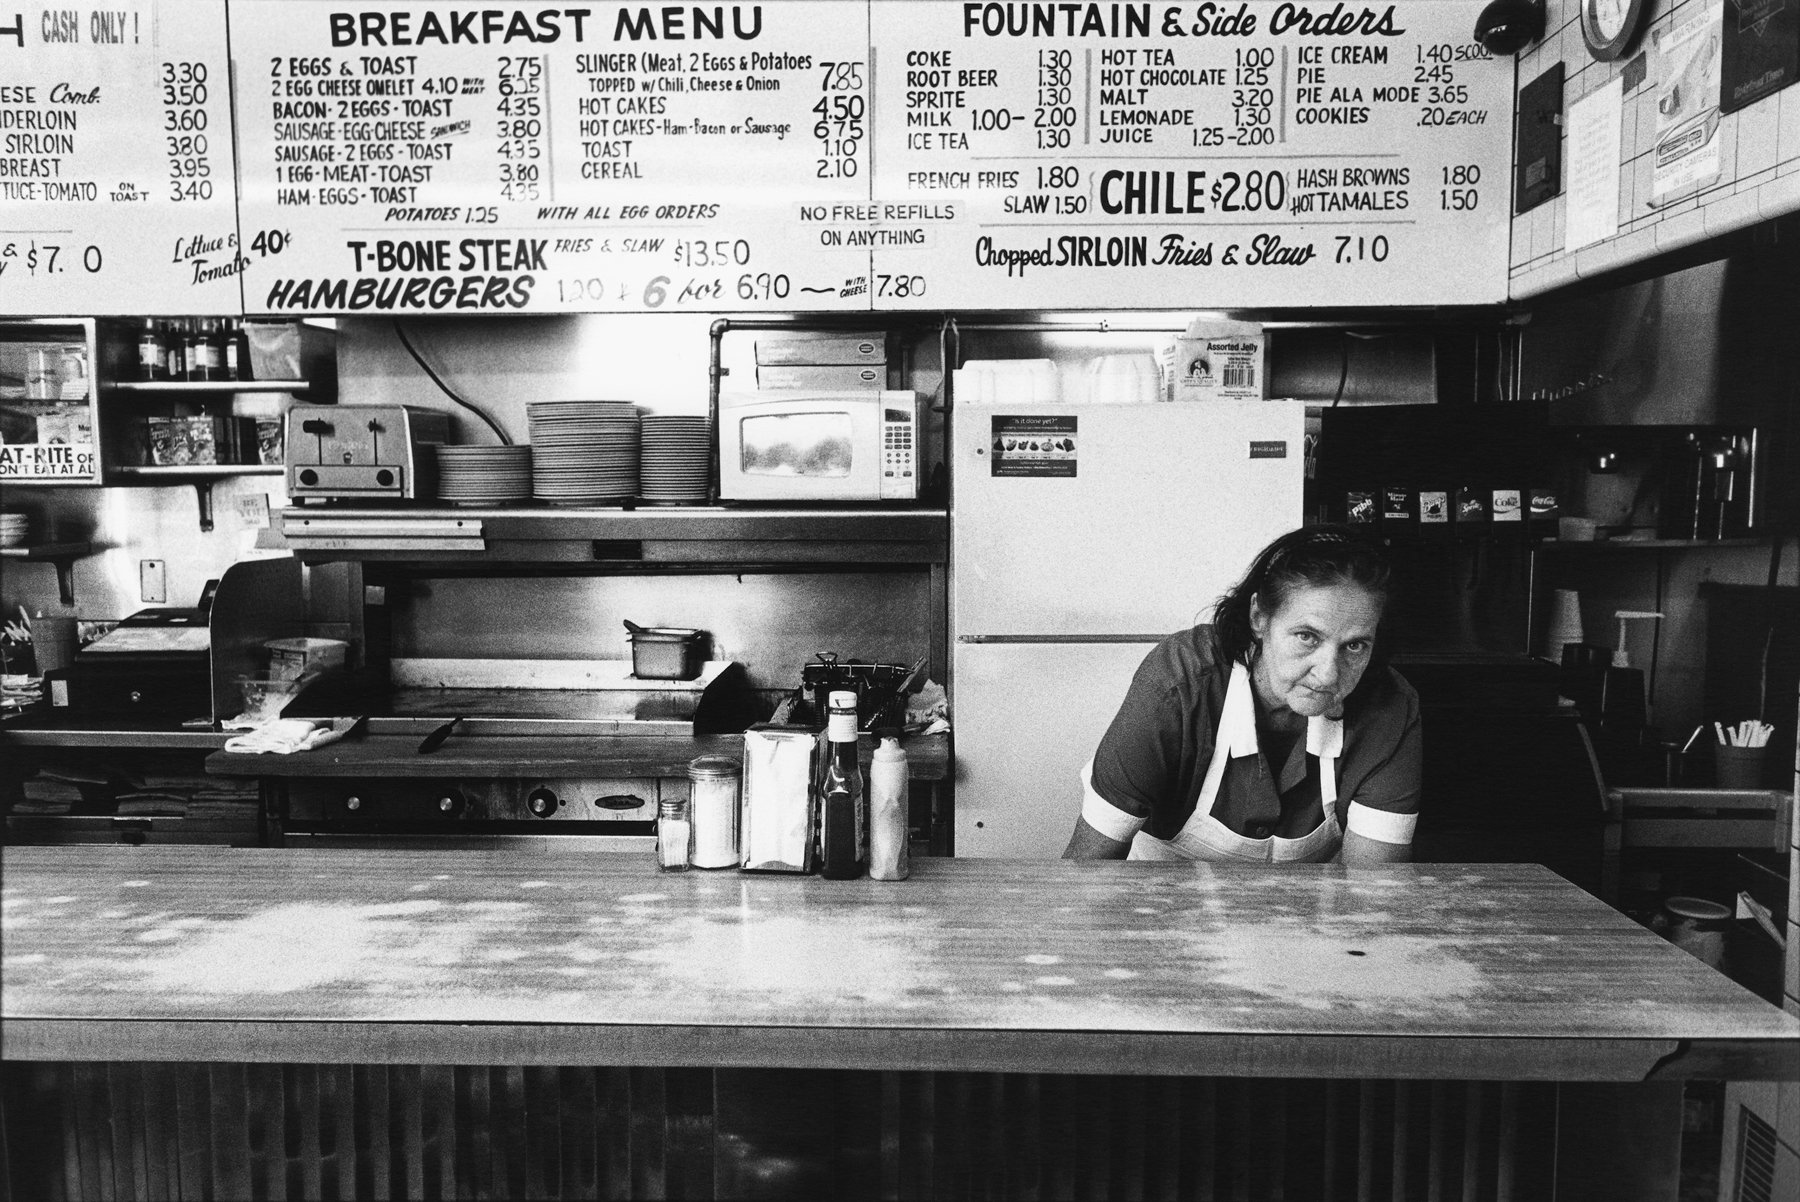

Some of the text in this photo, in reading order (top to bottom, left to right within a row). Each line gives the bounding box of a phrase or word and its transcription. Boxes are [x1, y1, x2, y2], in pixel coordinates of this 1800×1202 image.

[42, 10, 78, 43] CASH
[330, 6, 761, 47] BREAKFAST MENU
[964, 2, 1406, 37] FOUNTAIN & Side Orders
[907, 50, 1071, 72] COKE 1.30
[1102, 48, 1274, 70] HOT TEA 1.00
[1298, 44, 1452, 64] ICE CREAM 1.40
[163, 62, 207, 86] 3.30
[271, 56, 541, 80] 2 EGGS & TOAST 2.75
[576, 52, 864, 91] SLINGER 2 Eggs & Potatoes 7.85
[907, 67, 1071, 88] ROOT BEER 1.30
[1101, 65, 1271, 86] HOT CHOCOLATE 1.25
[1298, 65, 1453, 84] PIE 2.45
[164, 82, 207, 106] 3.50
[272, 81, 281, 96] 2
[286, 80, 312, 96] EGG
[318, 80, 361, 96] CHEESE
[366, 79, 414, 96] OMELET
[422, 77, 458, 94] 4.10
[589, 76, 780, 92] TOPPED Cheese & Onion
[1297, 85, 1468, 104] PIE MODE 3.65
[497, 94, 540, 116] 4.35
[907, 87, 1071, 108] SPRITE 1.30
[1101, 89, 1273, 110] MALT 3.20
[579, 95, 864, 122] HOT CAKES 4.50
[908, 111, 951, 127] MILK
[1100, 104, 1271, 126] LEMONADE 1.30
[1296, 107, 1488, 125] COOKIES EACH
[165, 109, 207, 131] 3.60
[498, 120, 541, 138] 3.80
[580, 117, 790, 140] HOT or Sausage
[6, 134, 207, 156] SIRLOIN 3.80
[909, 128, 1070, 150] ICE TEA 1.30
[1100, 128, 1153, 143] JUICE
[498, 139, 540, 158] 4.35
[582, 136, 859, 158] TOAST 1.10
[0, 158, 210, 178] BREAST 3.95
[582, 158, 857, 179] CEREAL 2.10
[909, 166, 1079, 189] FRENCH FRIES 1.80
[1298, 165, 1480, 188] HASH BROWNS 1.80
[110, 192, 149, 201] TOAST
[119, 180, 212, 201] ON 3.40
[1100, 170, 1285, 214] CHILE $2.80
[1441, 189, 1478, 210] 1.50
[385, 204, 720, 223] POTATOES 1.25 WITH ALL EGG ORDERS
[801, 205, 954, 220] NO FREE REFILLS
[1004, 195, 1087, 214] SLAW 1.50
[821, 229, 924, 246] ON ANYTHING
[347, 239, 664, 272] T-BONE STEAK FRIES & SLAW
[976, 234, 1316, 277] Chopped SIRLOIN Fries & Slaw
[192, 248, 251, 288] Tomato
[267, 273, 925, 310] HAMBURGERS 6 6.90 WITH 7.80
[840, 285, 867, 298] CHEESE
[1206, 342, 1258, 353] Assorted Jelly
[61, 464, 74, 474] AT
[1352, 499, 1372, 517] Pibb
